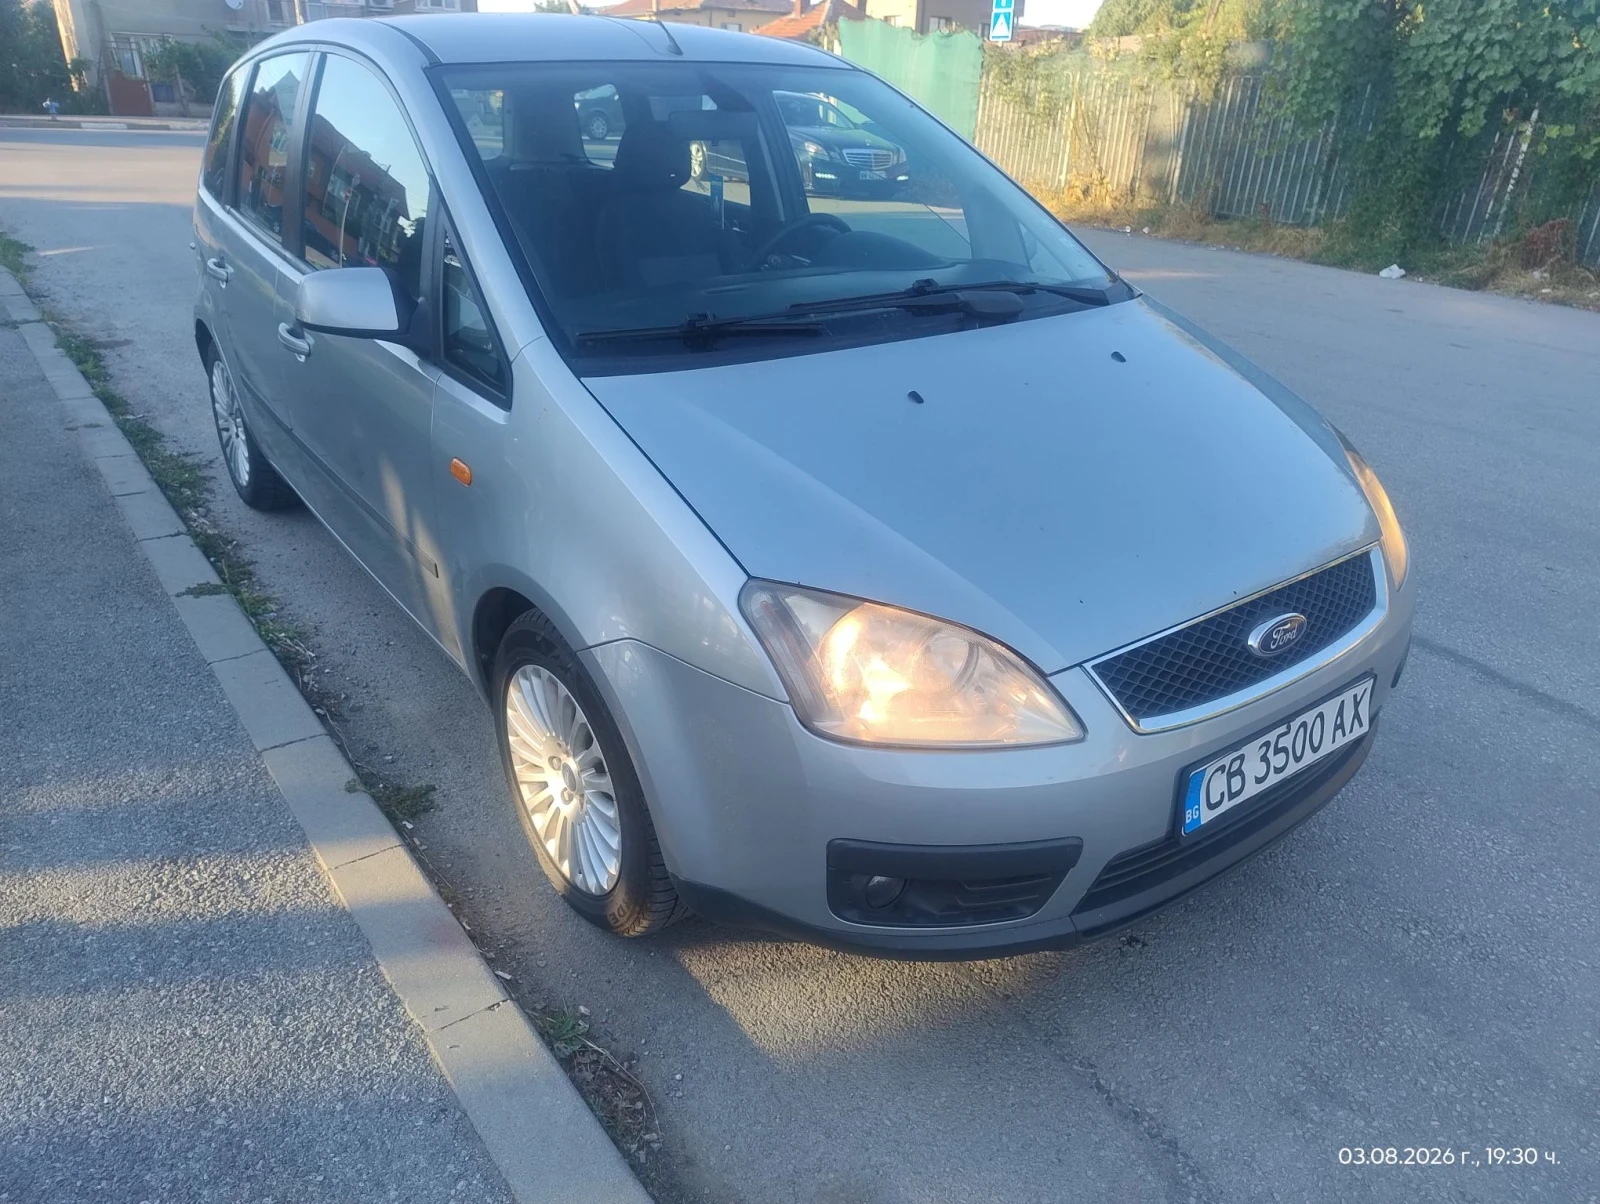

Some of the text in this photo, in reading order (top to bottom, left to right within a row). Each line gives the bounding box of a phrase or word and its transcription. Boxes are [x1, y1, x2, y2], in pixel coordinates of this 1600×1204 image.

[1270, 622, 1298, 650] Ford
[1205, 687, 1368, 811] CB 3500 AX
[1185, 805, 1199, 824] BG
